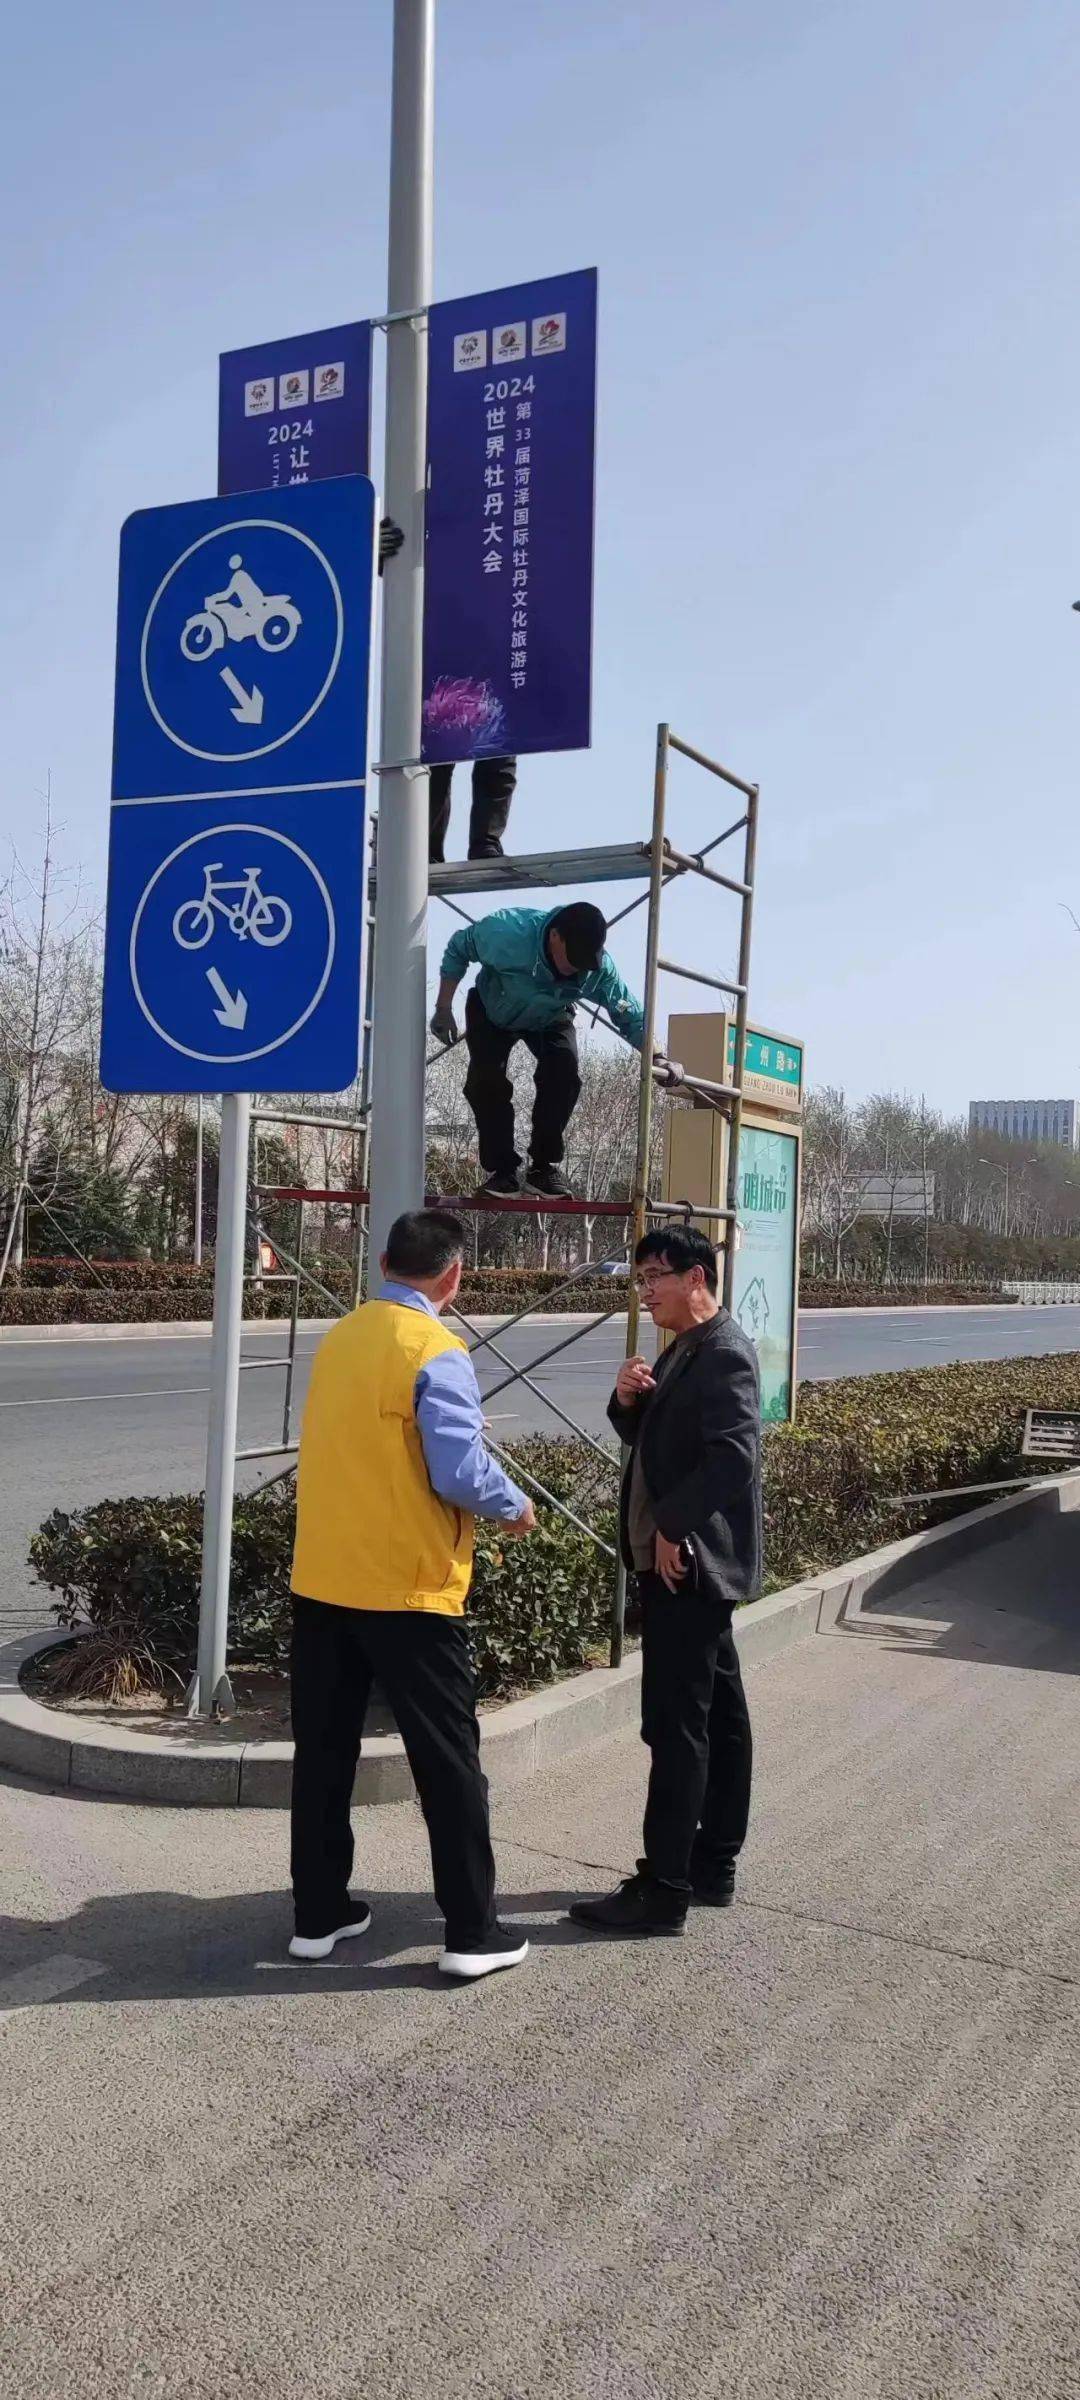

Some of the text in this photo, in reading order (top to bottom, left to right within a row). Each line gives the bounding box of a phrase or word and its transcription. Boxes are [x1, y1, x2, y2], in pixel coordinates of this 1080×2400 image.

[268, 419, 314, 445] 2024
[483, 374, 536, 402] 2024
[483, 406, 506, 573] 世界牡丹大会
[511, 401, 532, 689] 第33届菏泽国际牡丹文化旅游节
